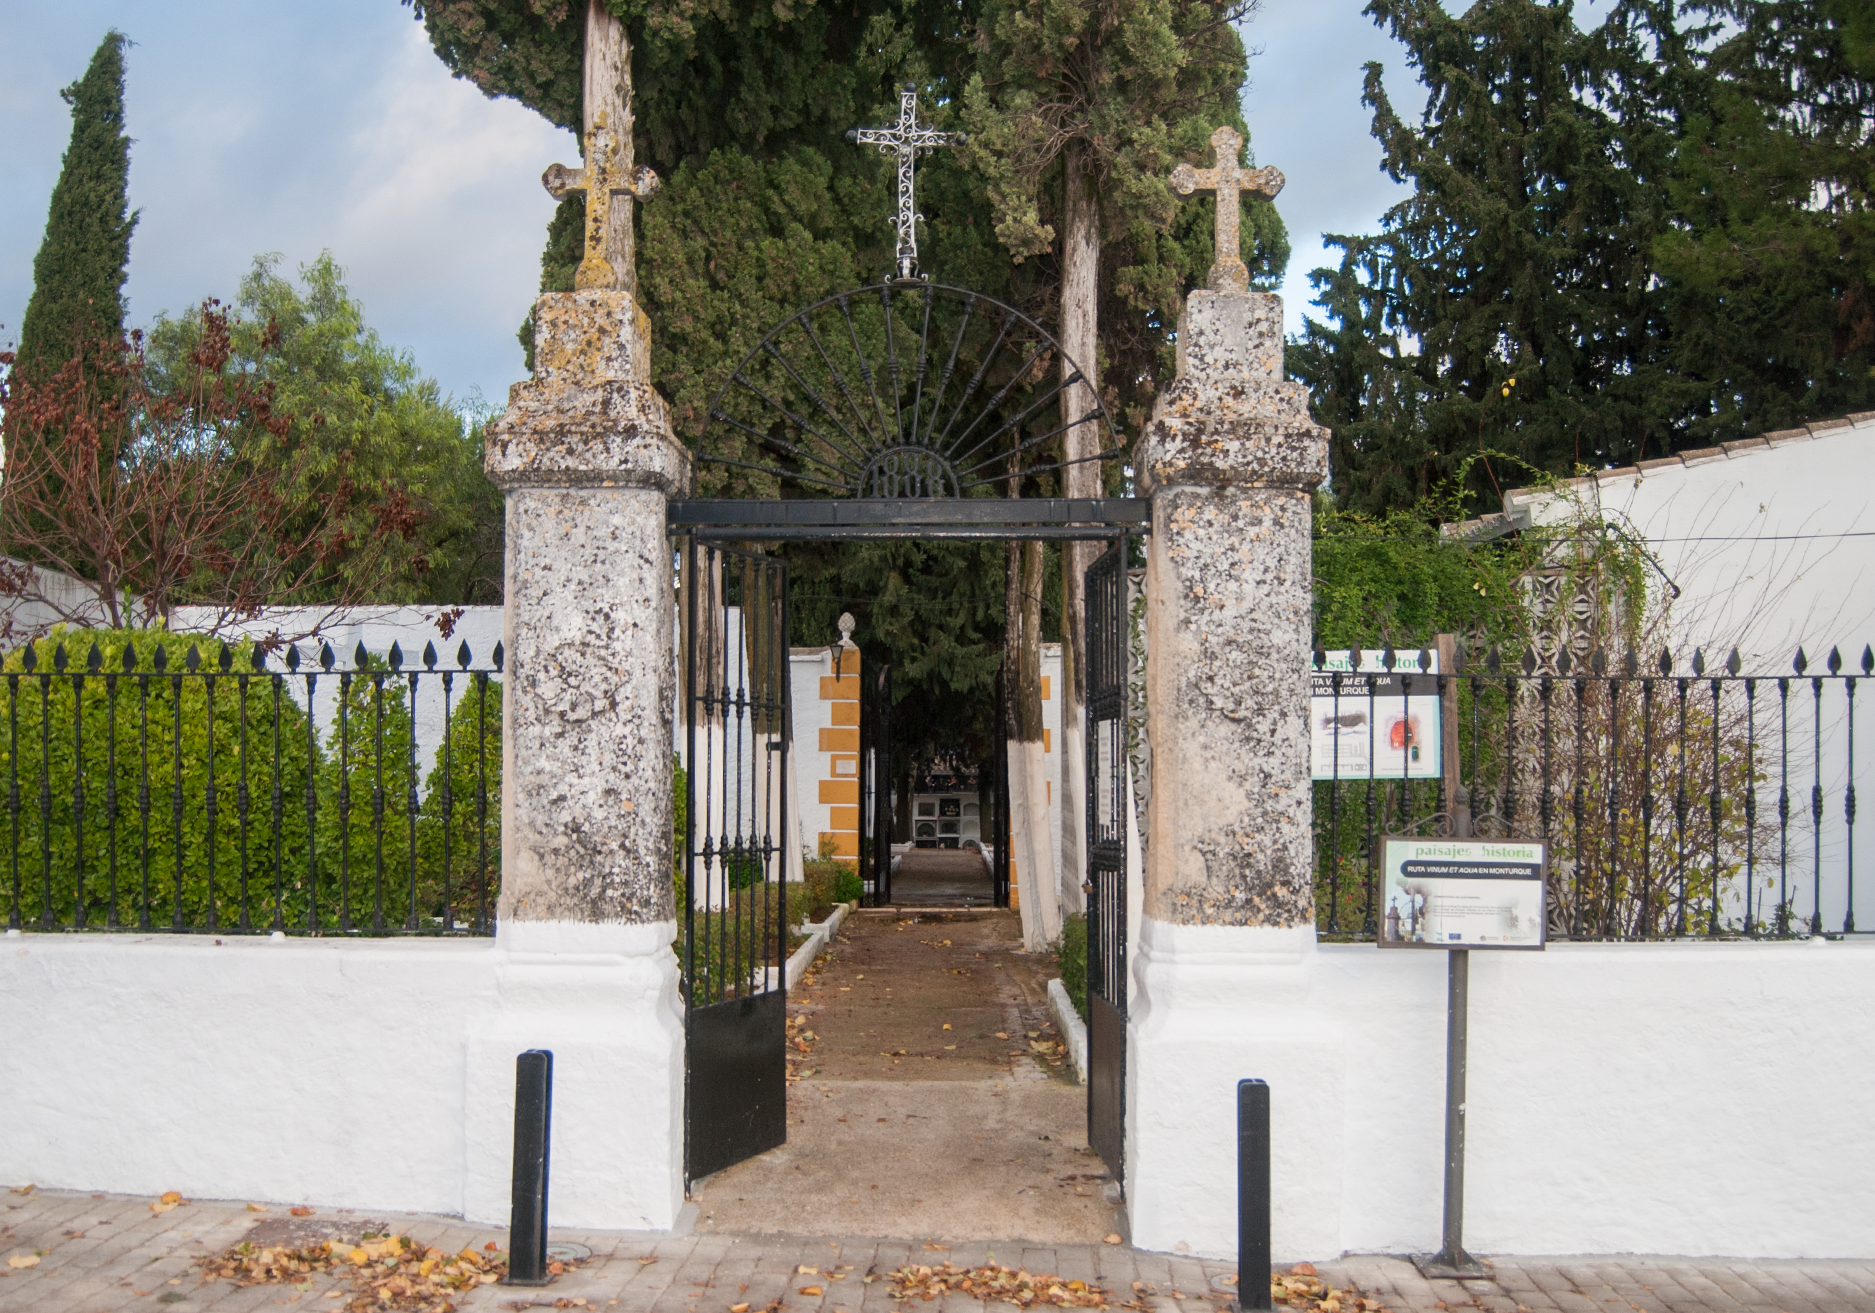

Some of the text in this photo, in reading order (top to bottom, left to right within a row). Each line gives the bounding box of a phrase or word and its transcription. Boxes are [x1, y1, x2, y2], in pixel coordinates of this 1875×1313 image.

[1315, 686, 1370, 695] MONURQUE
[1415, 845, 1534, 859] paisajes historia
[1426, 866, 1448, 874] VINUM
[1489, 867, 1532, 875] MONTURQUE
